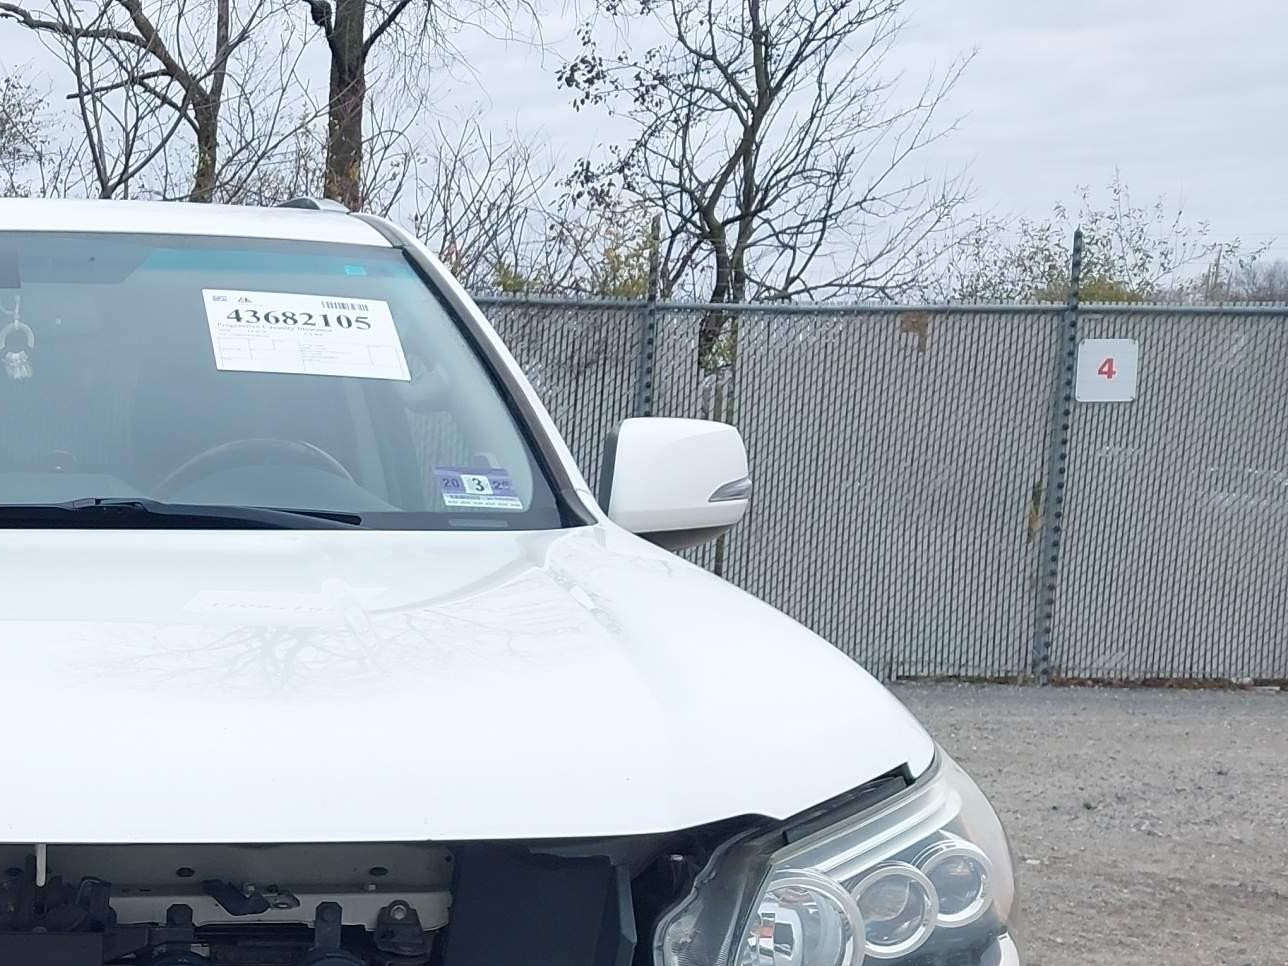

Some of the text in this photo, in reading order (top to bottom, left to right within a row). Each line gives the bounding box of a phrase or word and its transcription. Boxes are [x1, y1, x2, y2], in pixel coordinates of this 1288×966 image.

[226, 308, 372, 330] 43682105
[1097, 358, 1117, 379] 4
[472, 477, 485, 491] 3
